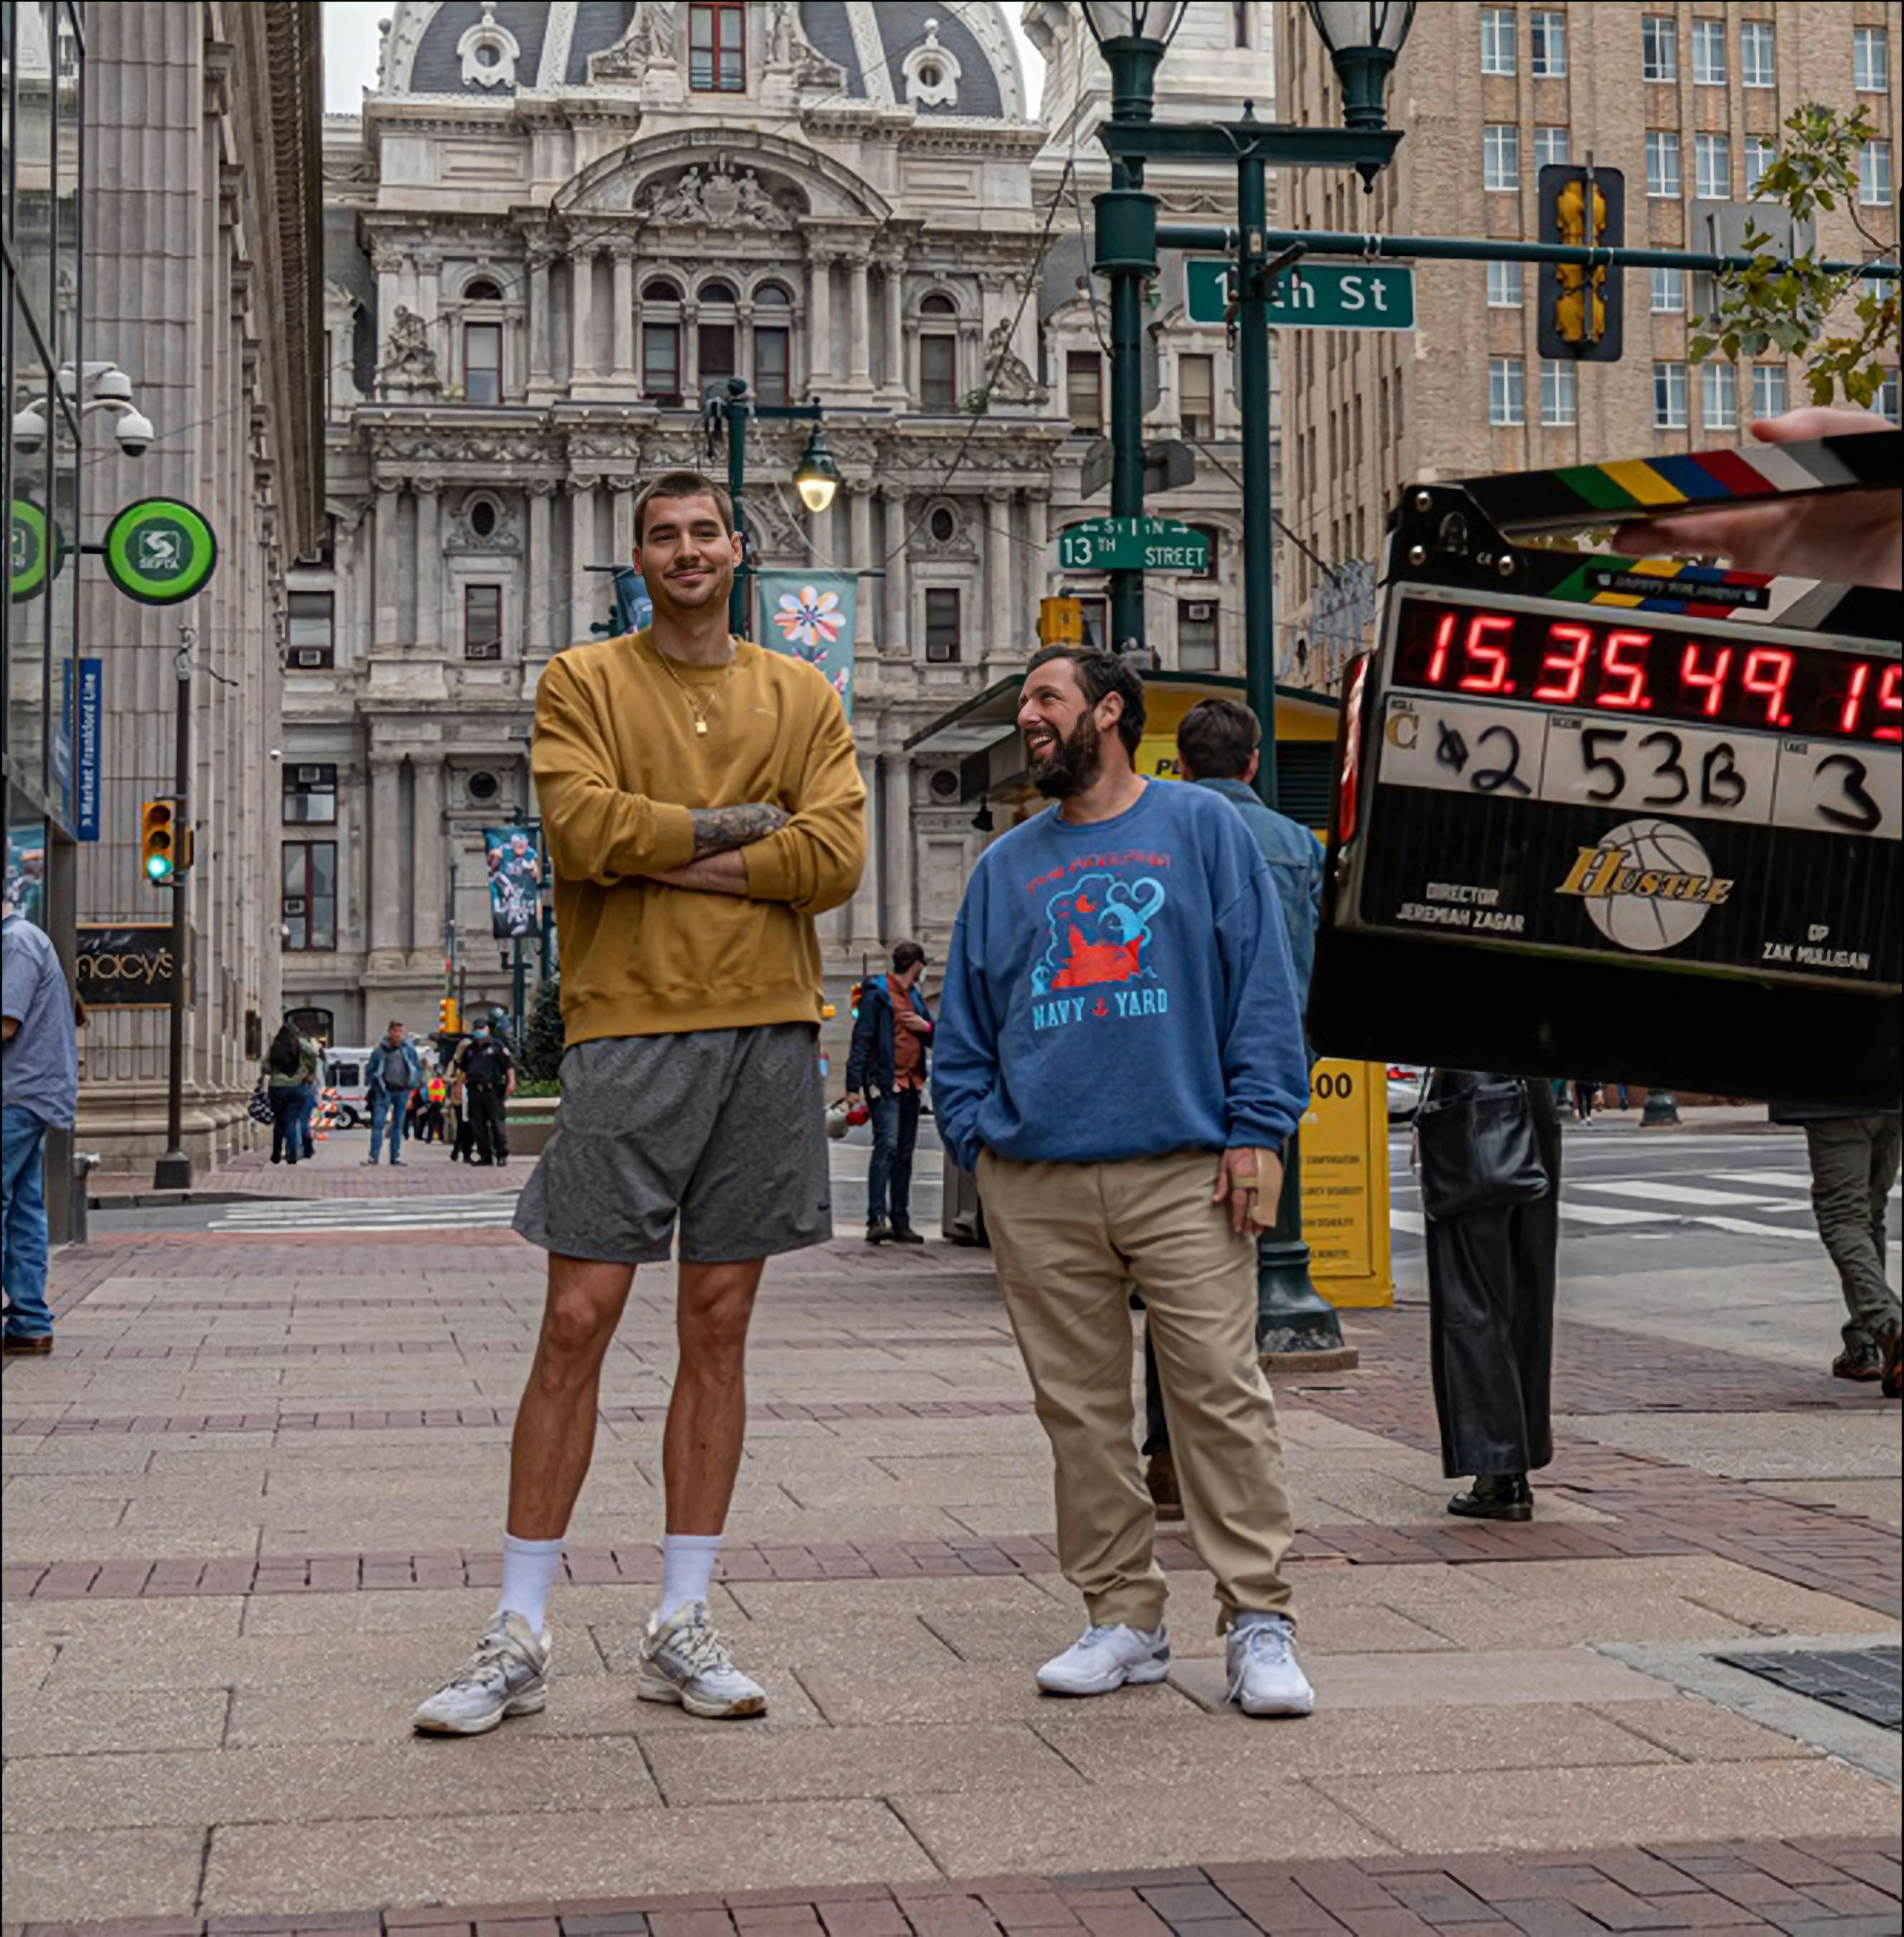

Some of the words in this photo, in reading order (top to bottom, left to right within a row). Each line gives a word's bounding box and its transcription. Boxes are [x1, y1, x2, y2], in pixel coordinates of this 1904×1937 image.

[1215, 271, 1315, 308] 1h
[1340, 275, 1388, 311] St
[1144, 546, 1205, 566] STREET
[1814, 754, 1882, 832] 3
[1426, 882, 1499, 905] DIRECTOR
[1032, 997, 1085, 1030] NAVY
[1114, 988, 1168, 1017] YARD
[1310, 1073, 1352, 1099] 00
